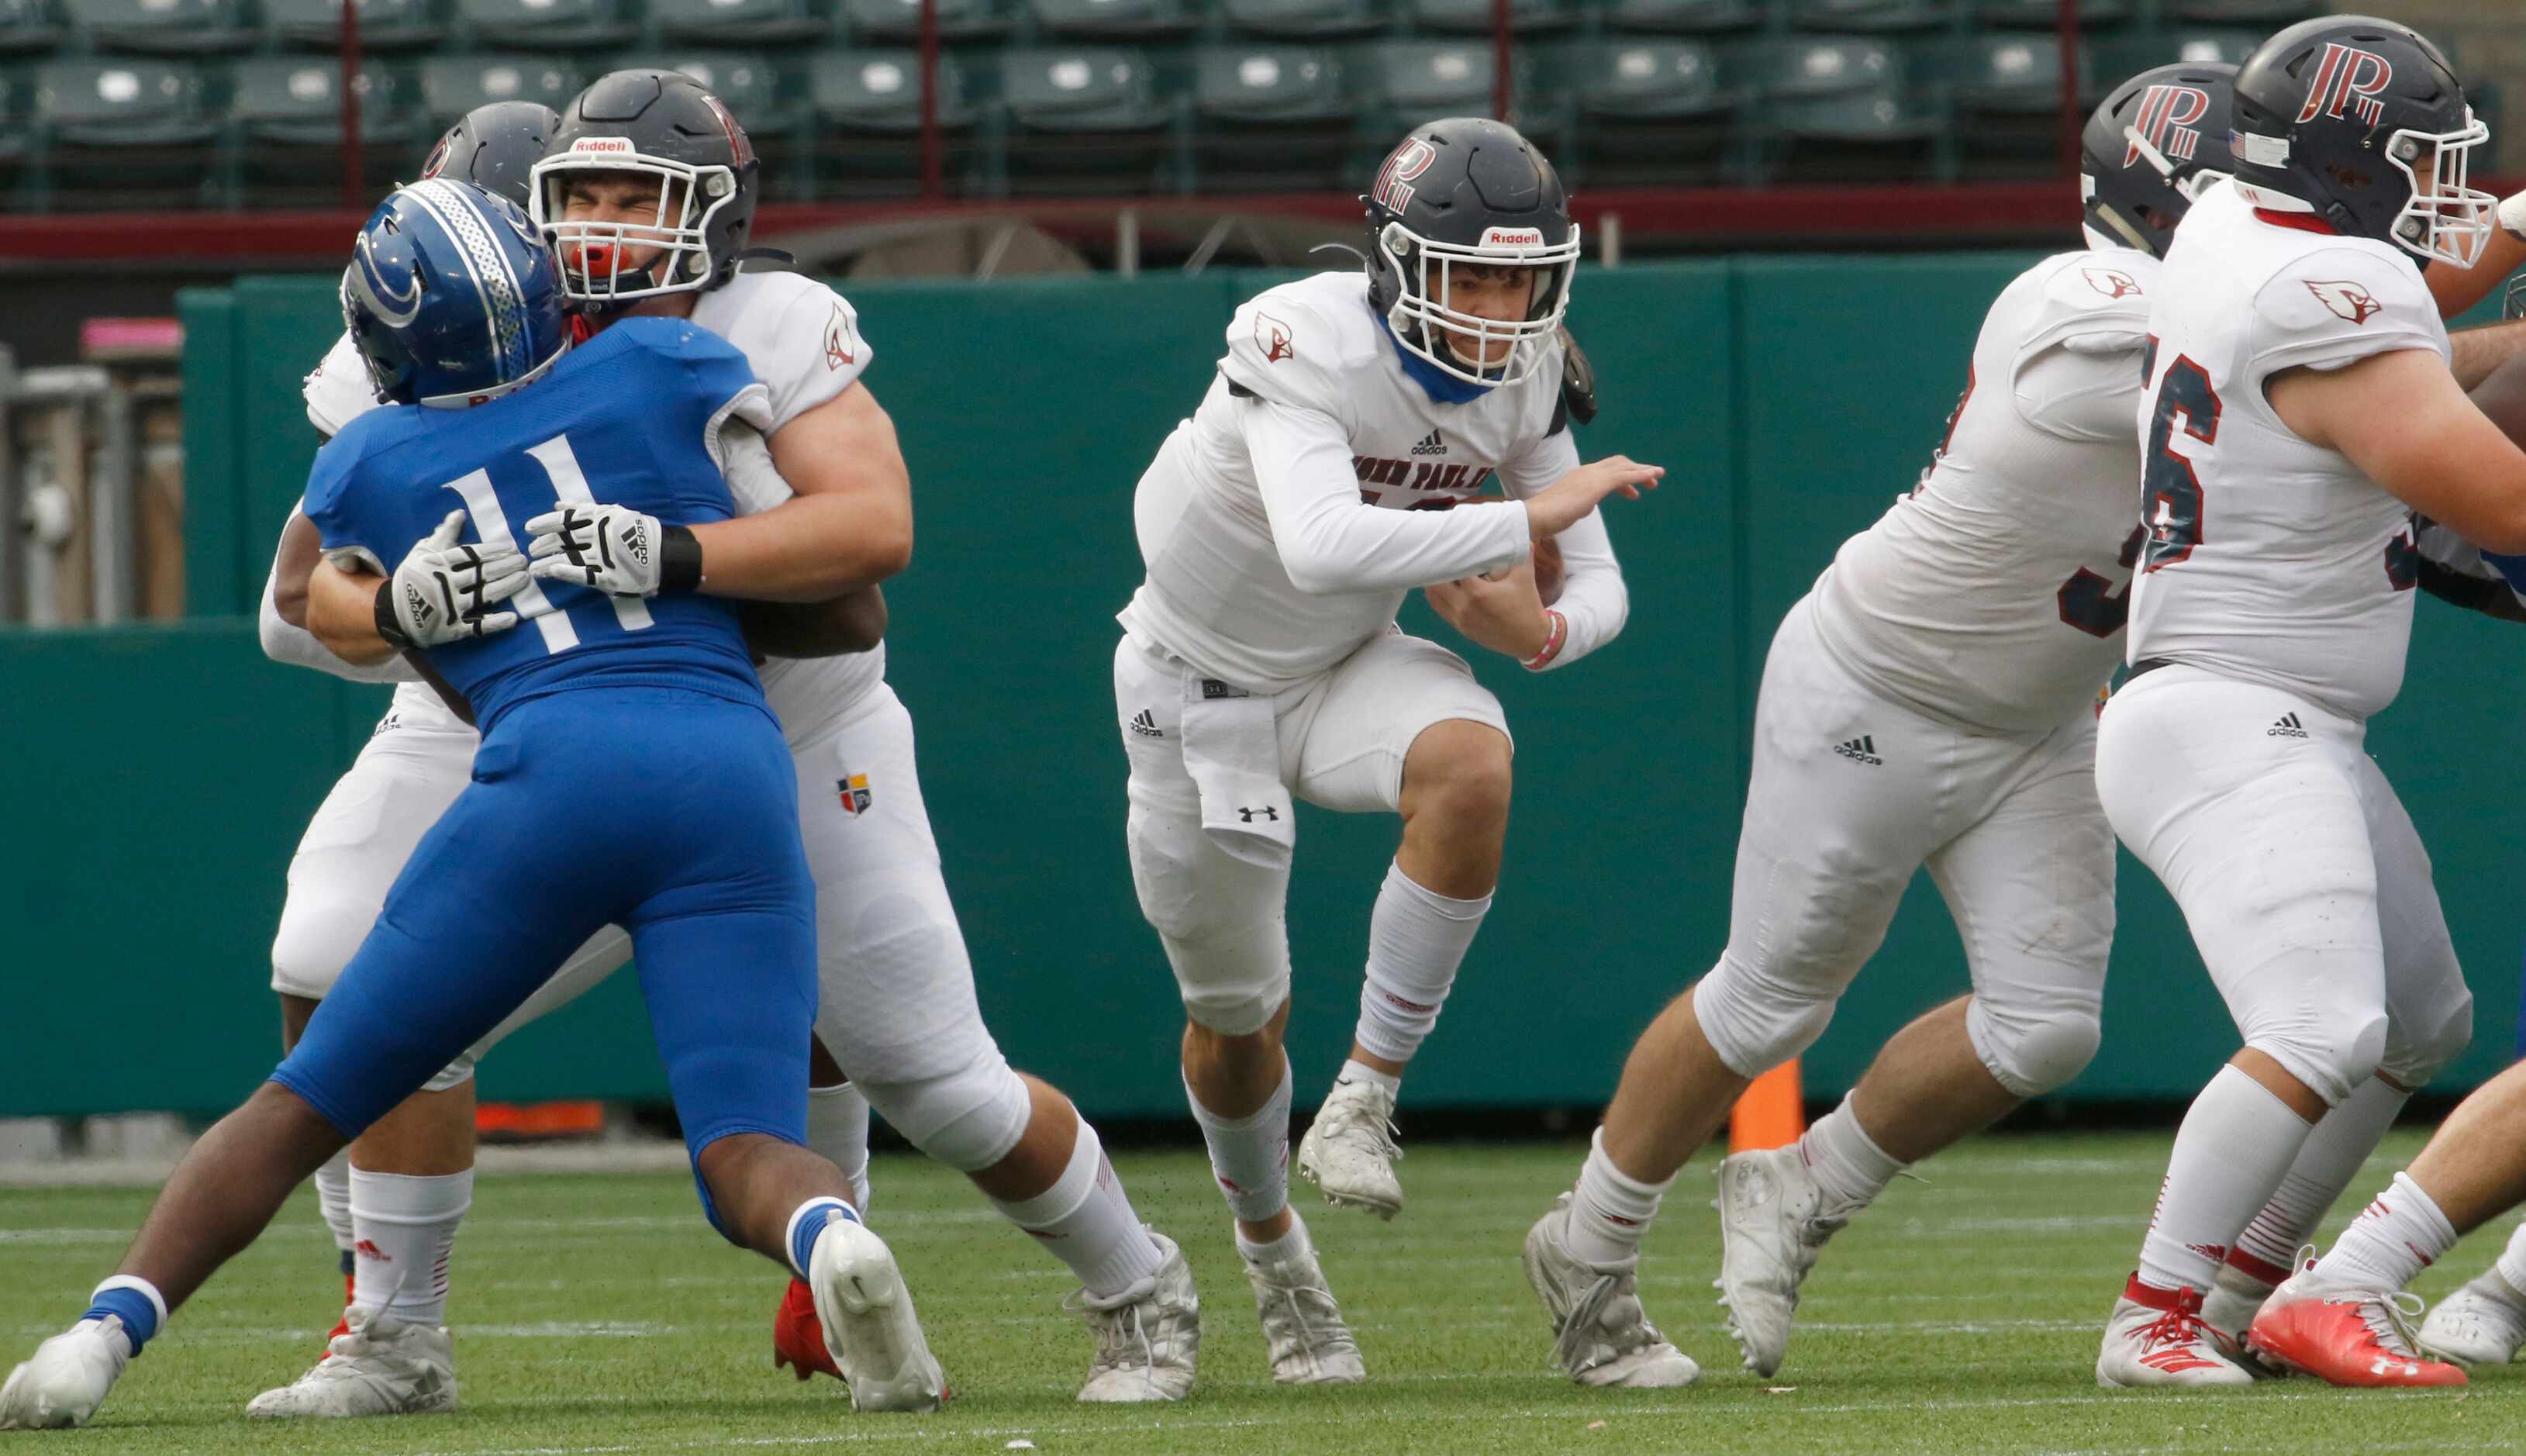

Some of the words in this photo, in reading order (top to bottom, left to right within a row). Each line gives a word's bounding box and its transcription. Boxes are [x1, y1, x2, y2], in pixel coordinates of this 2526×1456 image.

[575, 142, 626, 151] Riddell
[1491, 233, 1538, 243] Riddell
[1411, 445, 1448, 455] adidas
[1410, 462, 1471, 491] PAUL
[440, 433, 656, 655] 11
[635, 519, 650, 566] adidas
[405, 583, 424, 629] adidas
[1130, 722, 1163, 737] adidas
[2267, 727, 2309, 738] adida
[1834, 745, 1882, 766] adidas
